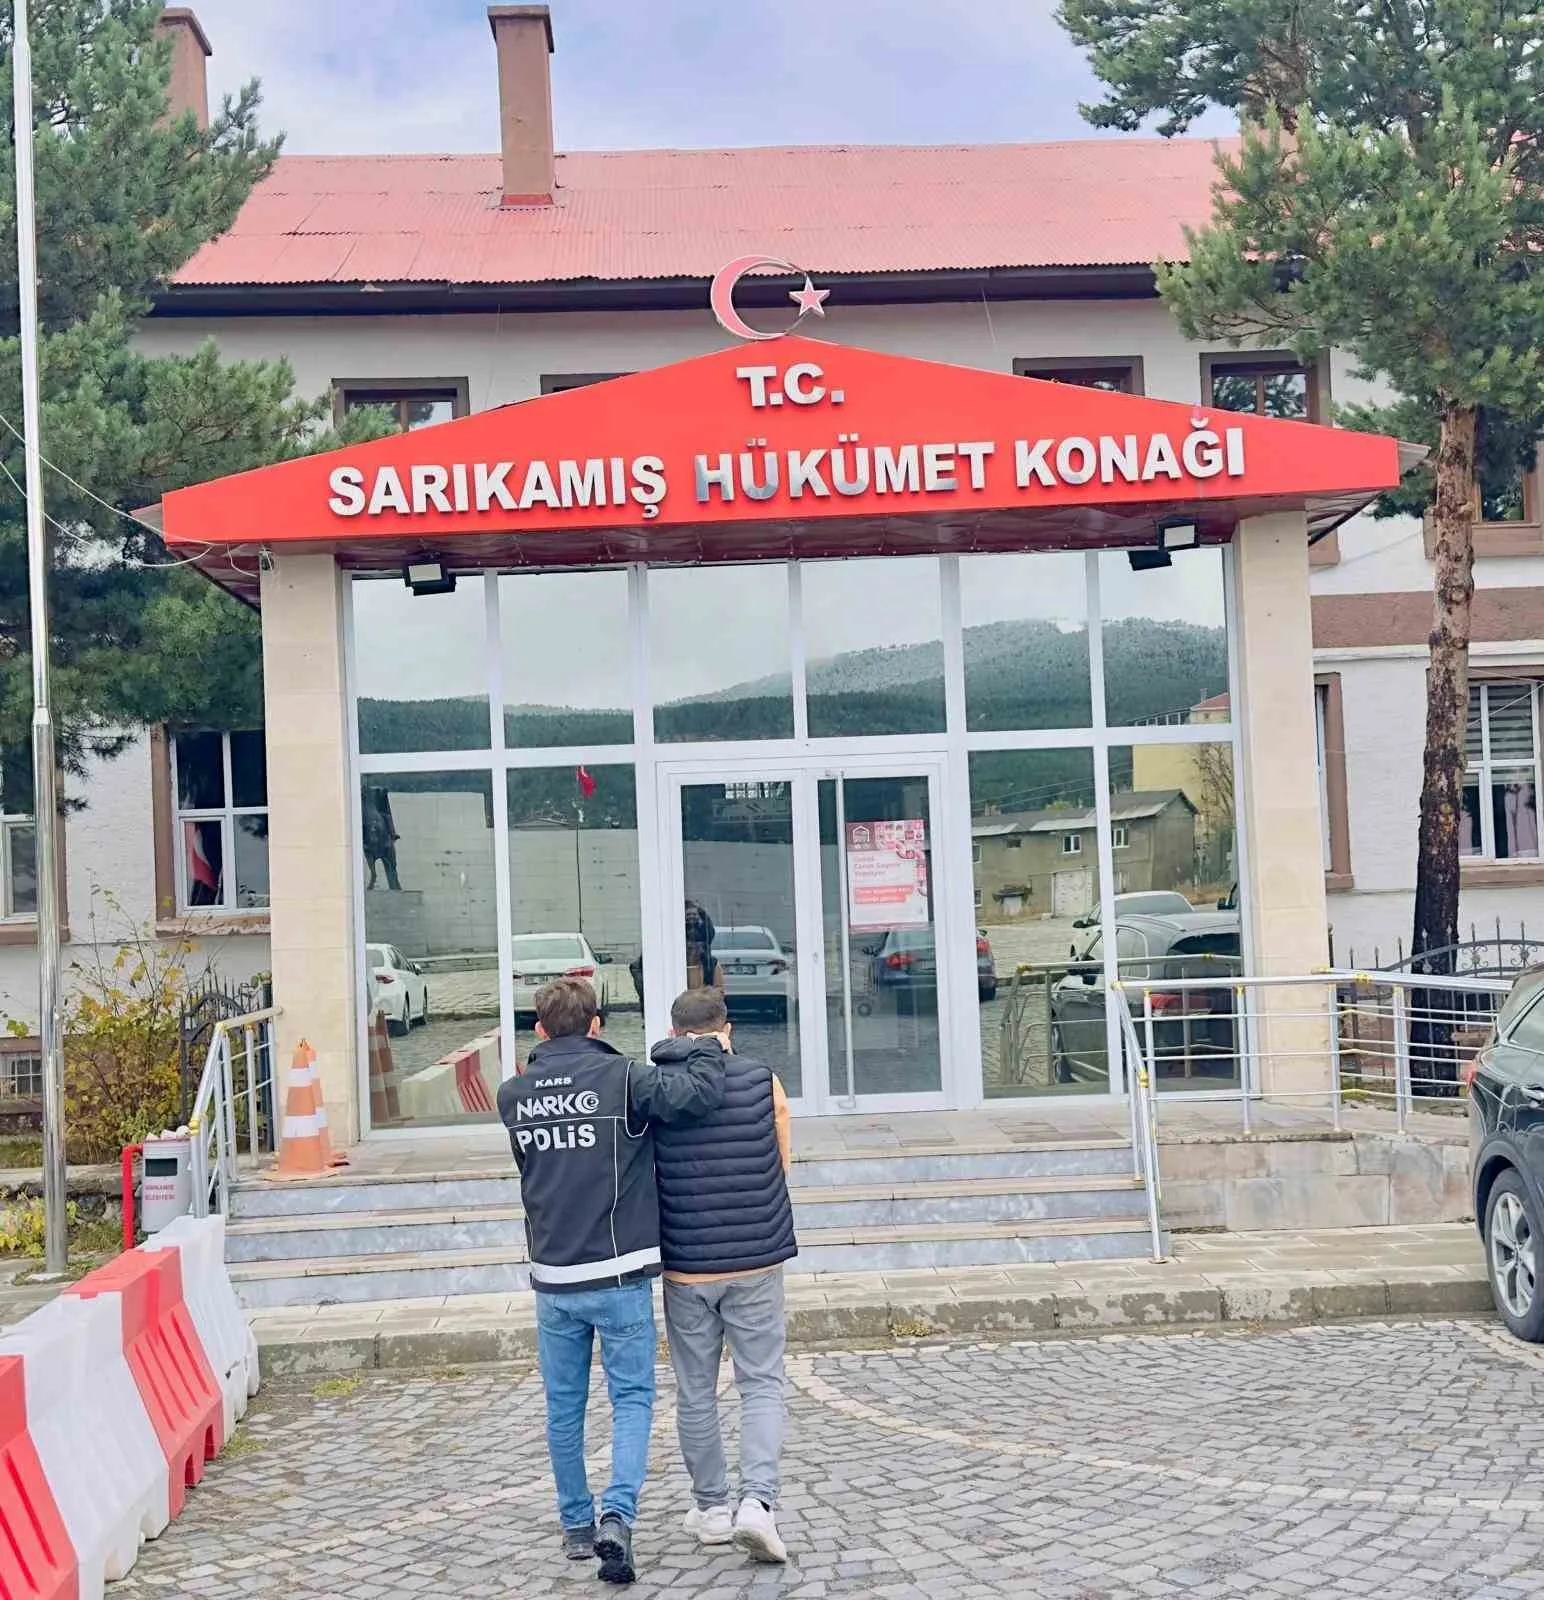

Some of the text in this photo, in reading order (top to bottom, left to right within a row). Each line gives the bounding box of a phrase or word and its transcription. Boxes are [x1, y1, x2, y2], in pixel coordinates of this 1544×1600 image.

[736, 362, 845, 407] T.C.
[328, 415, 1246, 519] SARIKAMIŞ HÜKÜMET KONAĞI
[535, 1077, 572, 1088] KARS
